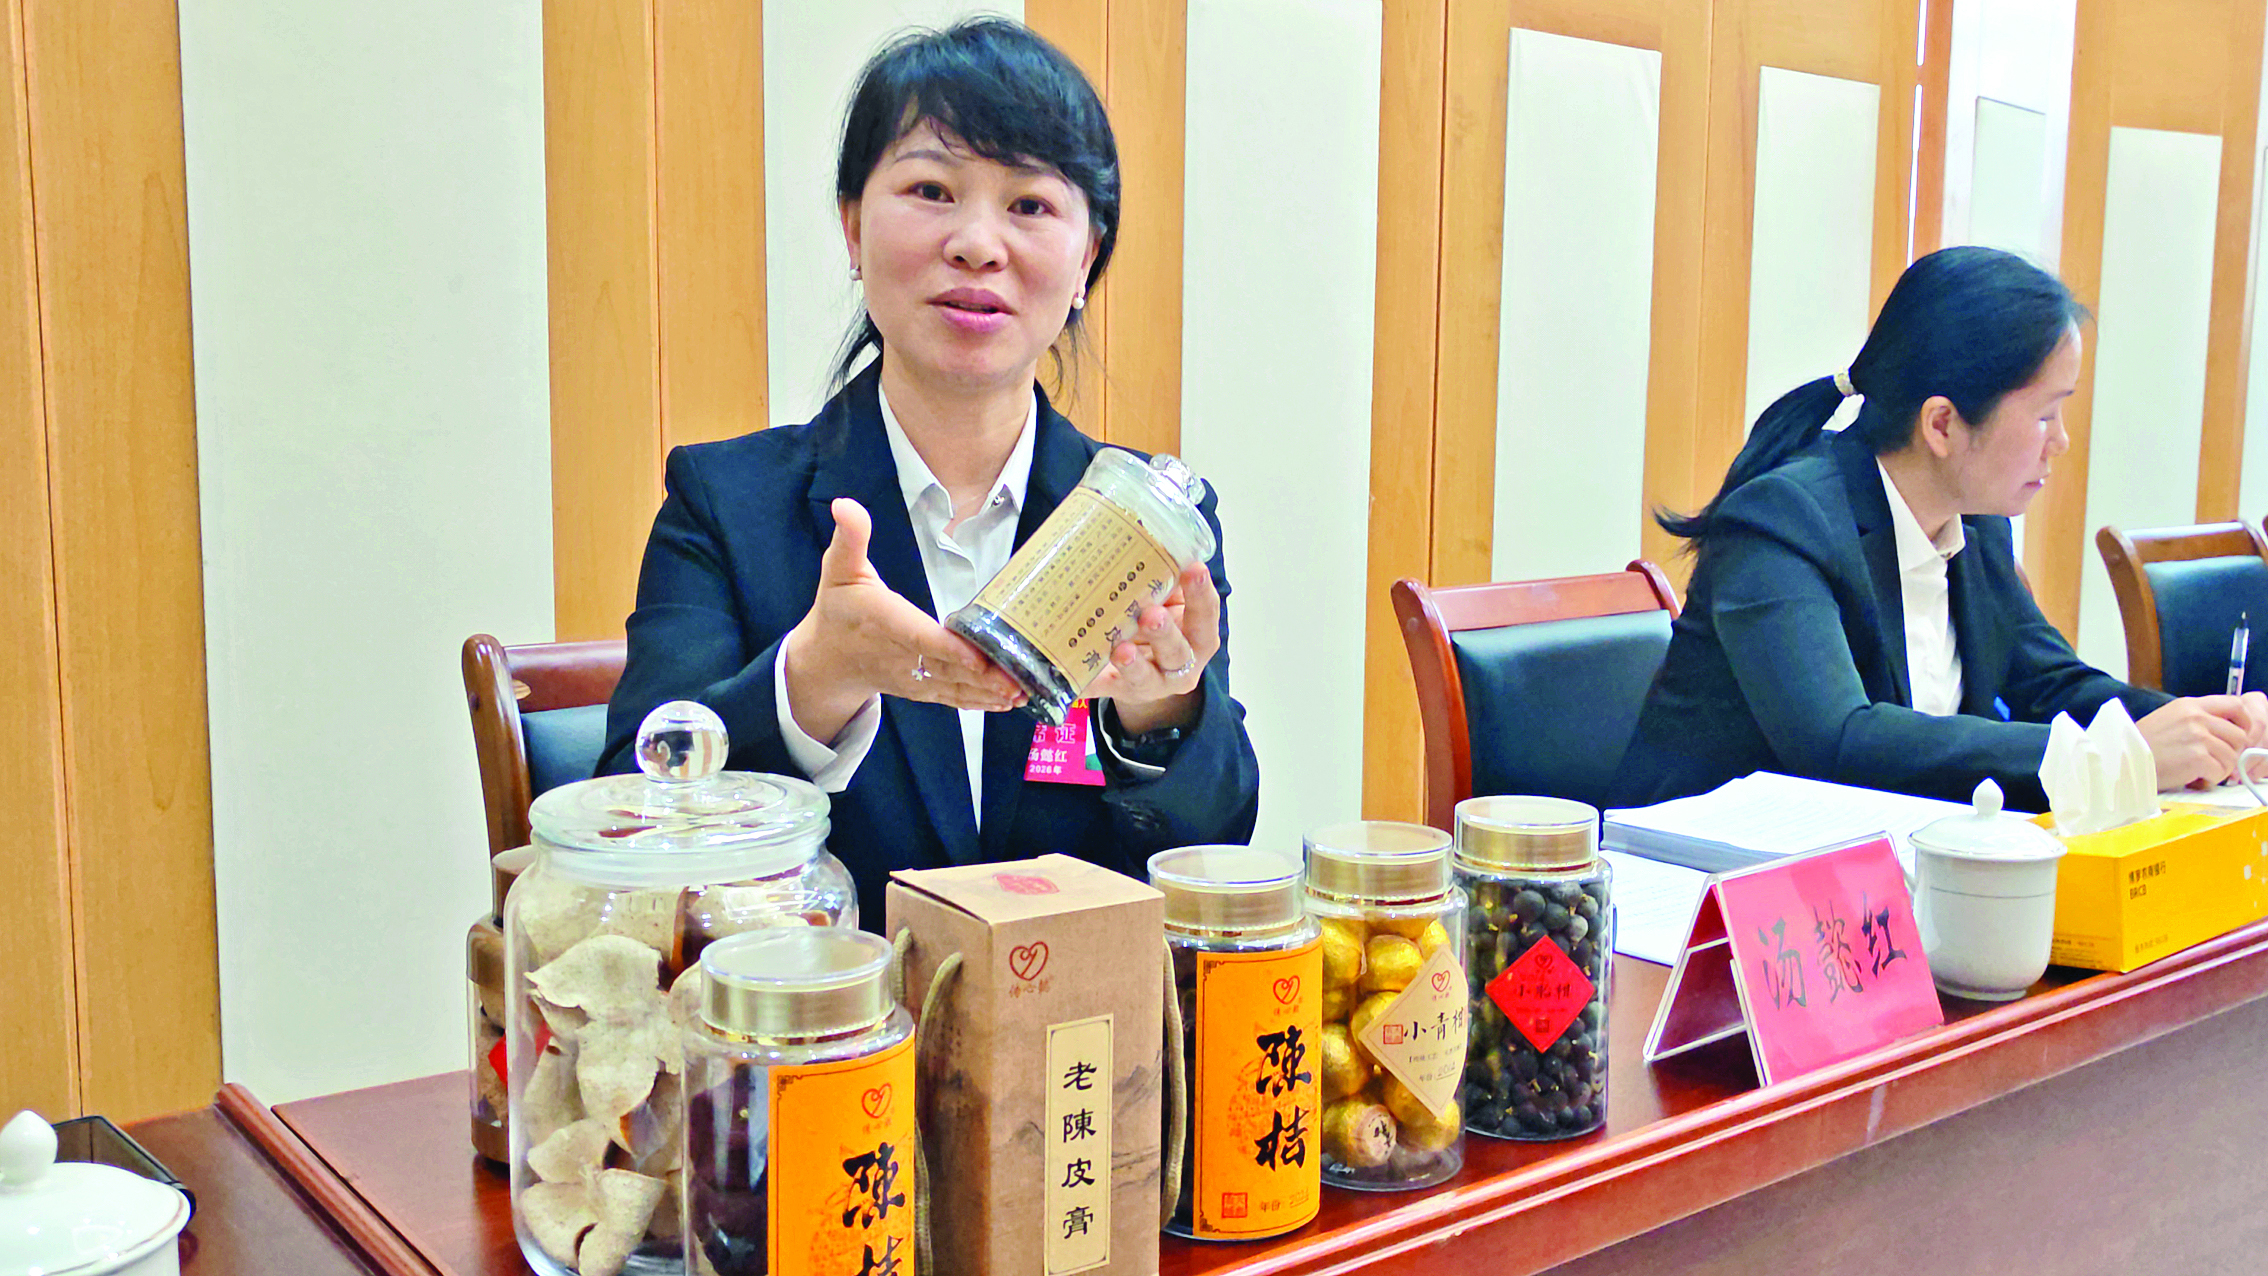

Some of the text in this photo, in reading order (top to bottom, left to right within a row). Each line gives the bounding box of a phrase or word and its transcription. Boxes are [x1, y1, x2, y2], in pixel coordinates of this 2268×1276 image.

[1757, 890, 1908, 1011] 汤懿红
[1062, 1061, 1097, 1240] 老陳皮膏
